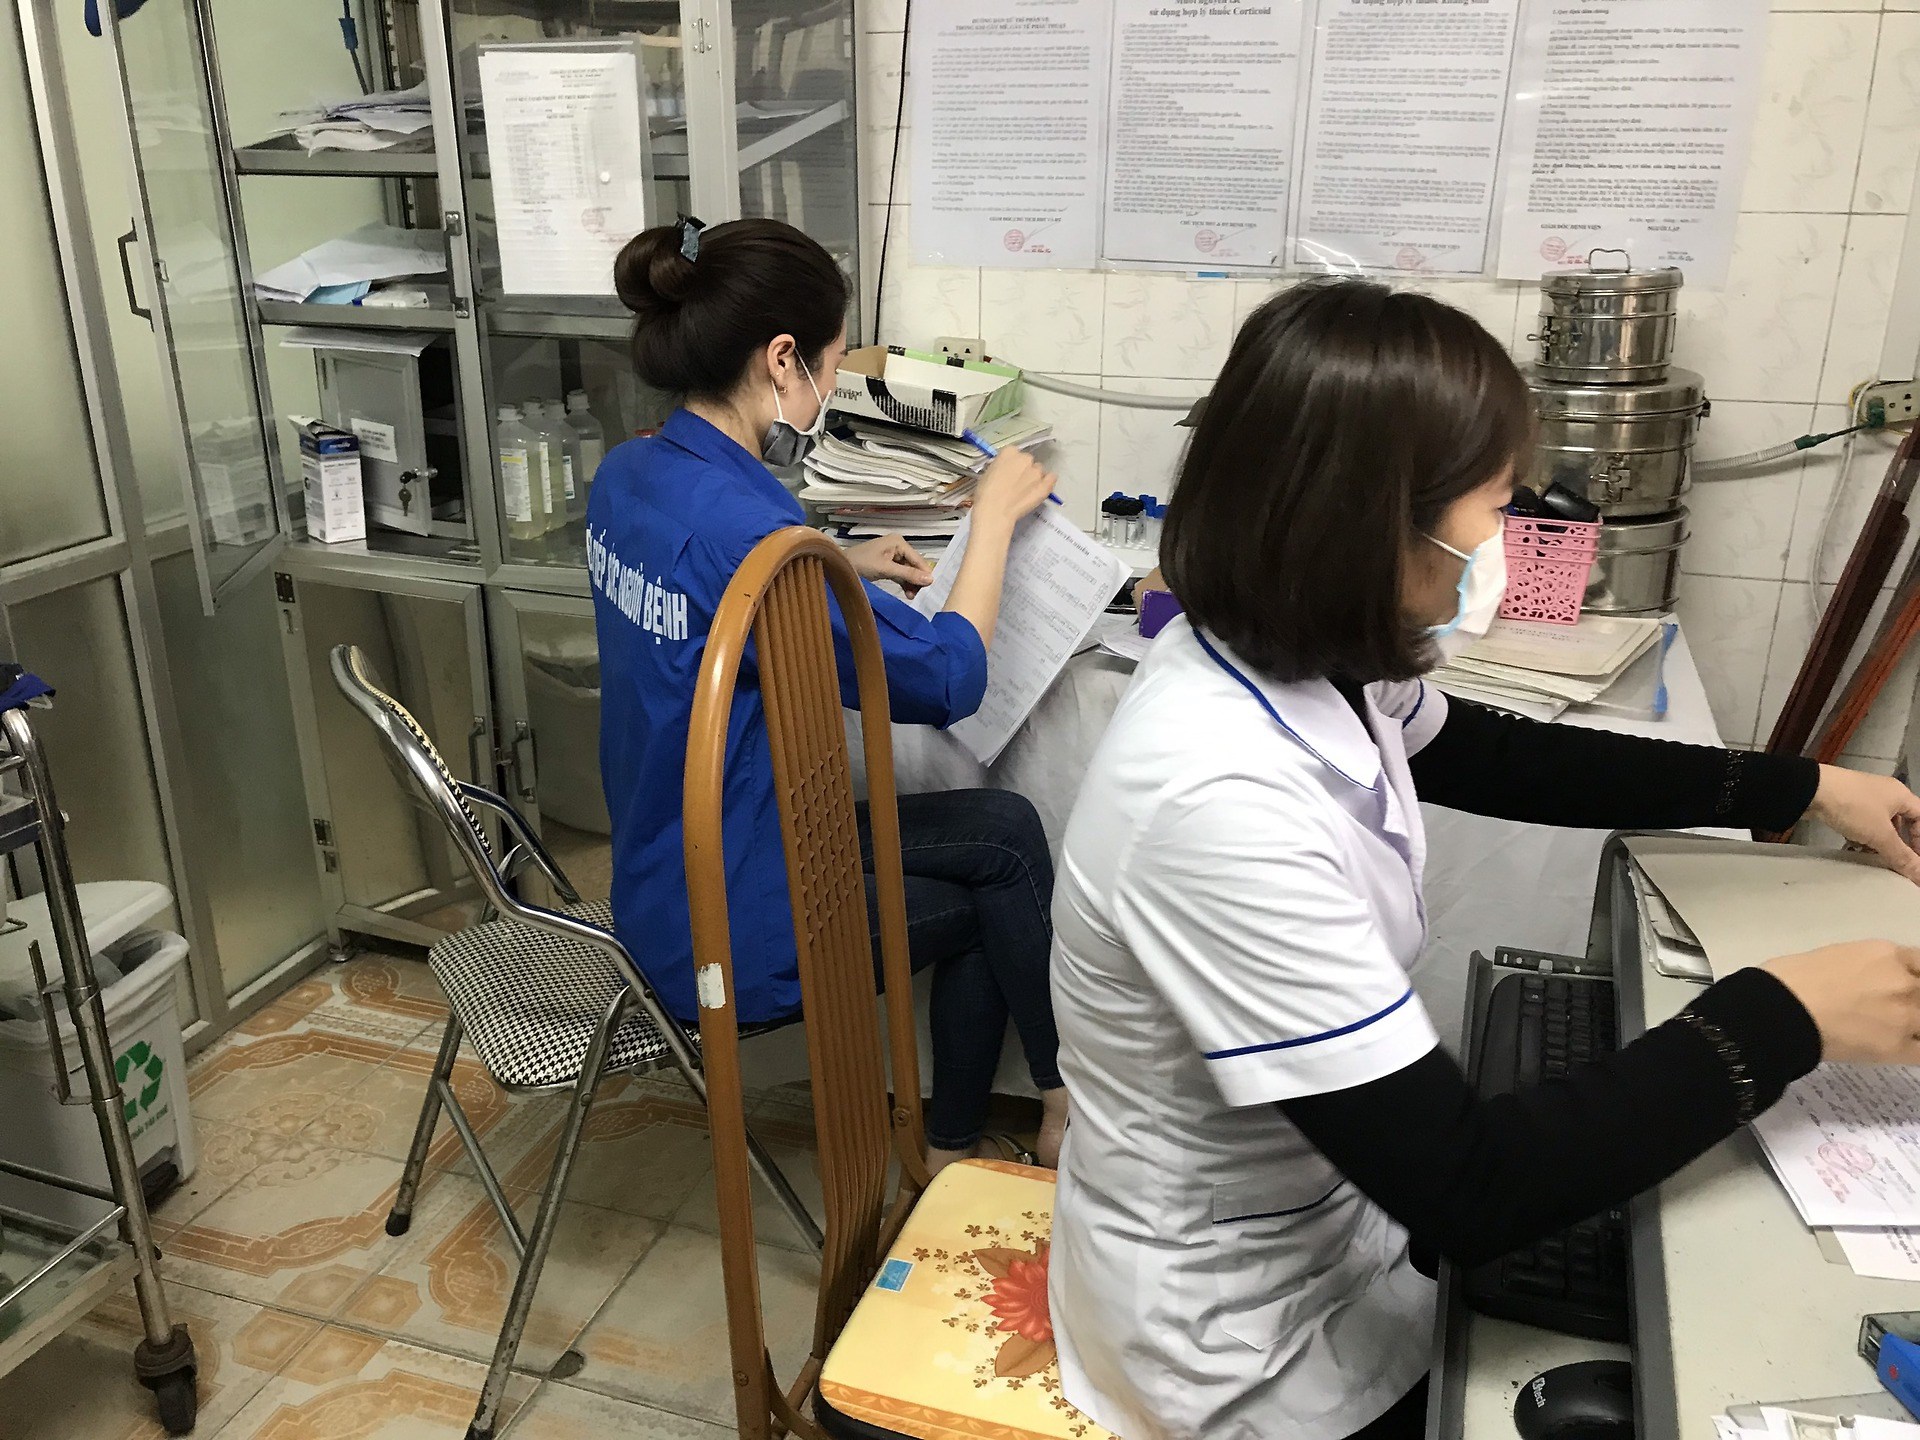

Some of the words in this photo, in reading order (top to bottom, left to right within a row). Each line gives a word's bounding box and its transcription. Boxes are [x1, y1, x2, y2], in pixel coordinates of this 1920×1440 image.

[1160, 8, 1180, 18] dụng
[1182, 8, 1198, 18] hợp
[1208, 6, 1230, 16] thuốc
[1232, 6, 1271, 16] Corticoid
[643, 576, 688, 645] BỆNH
